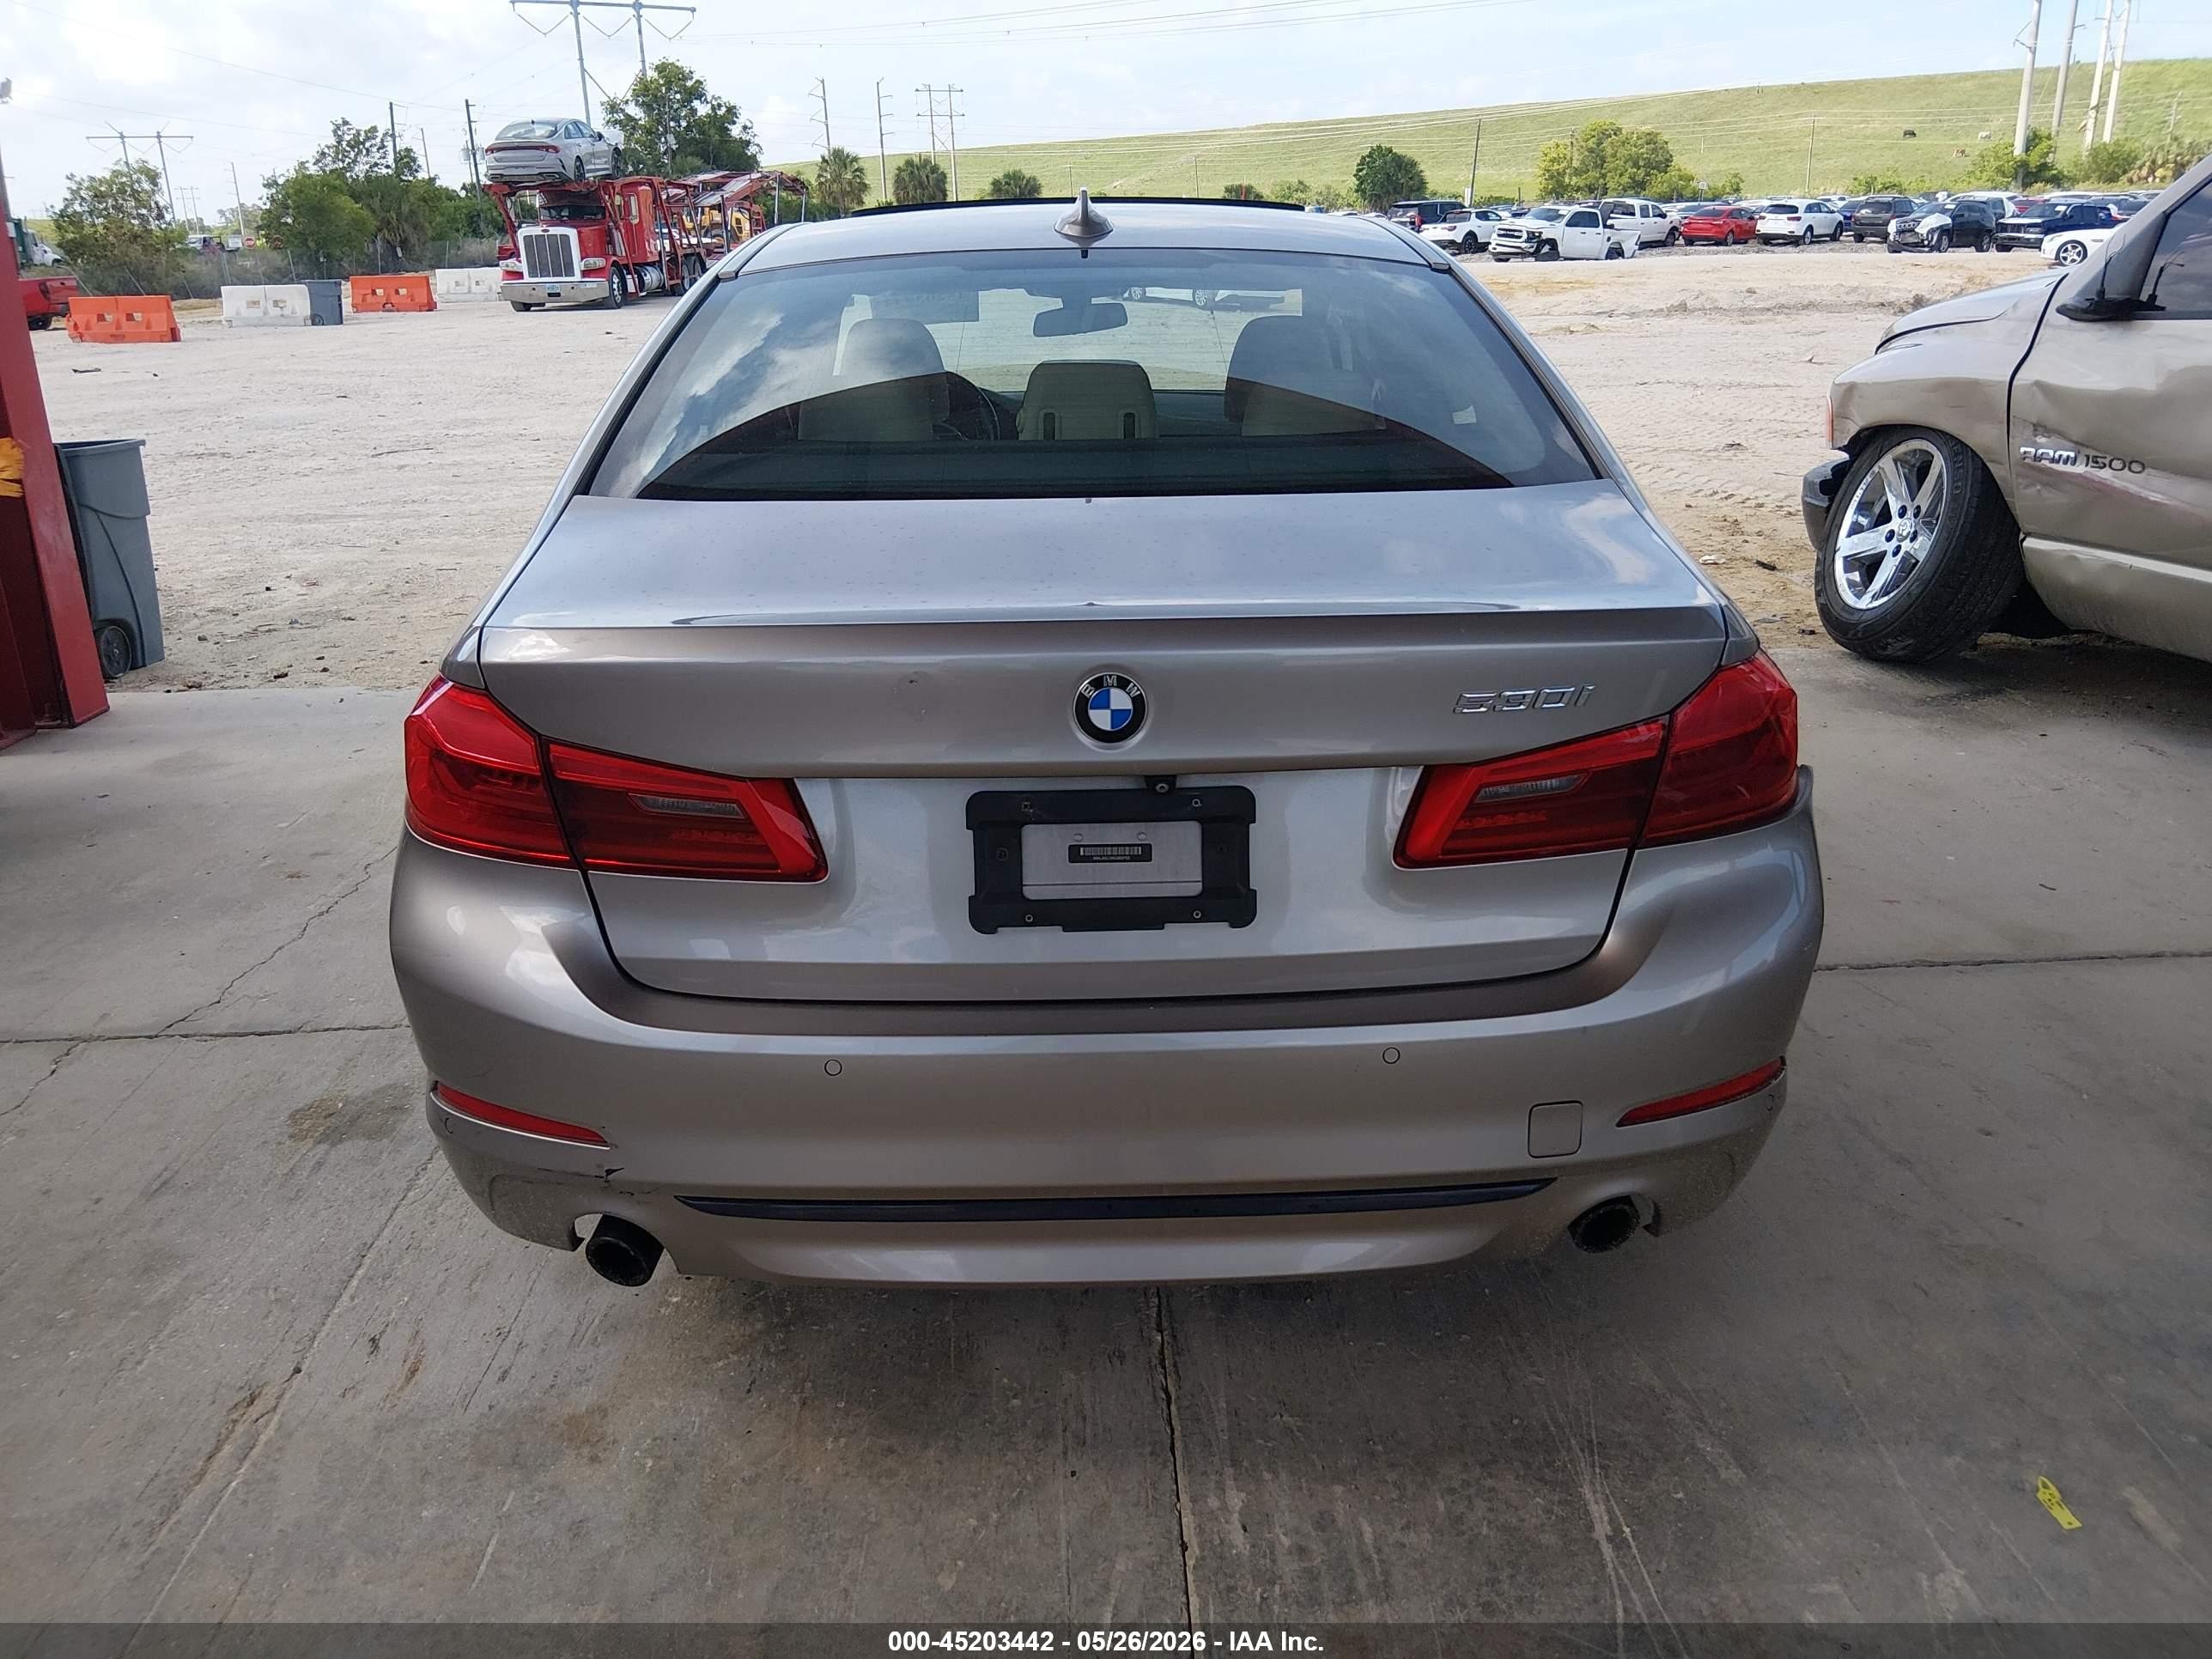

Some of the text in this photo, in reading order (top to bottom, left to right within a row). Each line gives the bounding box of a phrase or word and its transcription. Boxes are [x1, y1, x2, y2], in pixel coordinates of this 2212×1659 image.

[2020, 447, 2146, 474] RAM 1500
[1081, 675, 1140, 698] BMW
